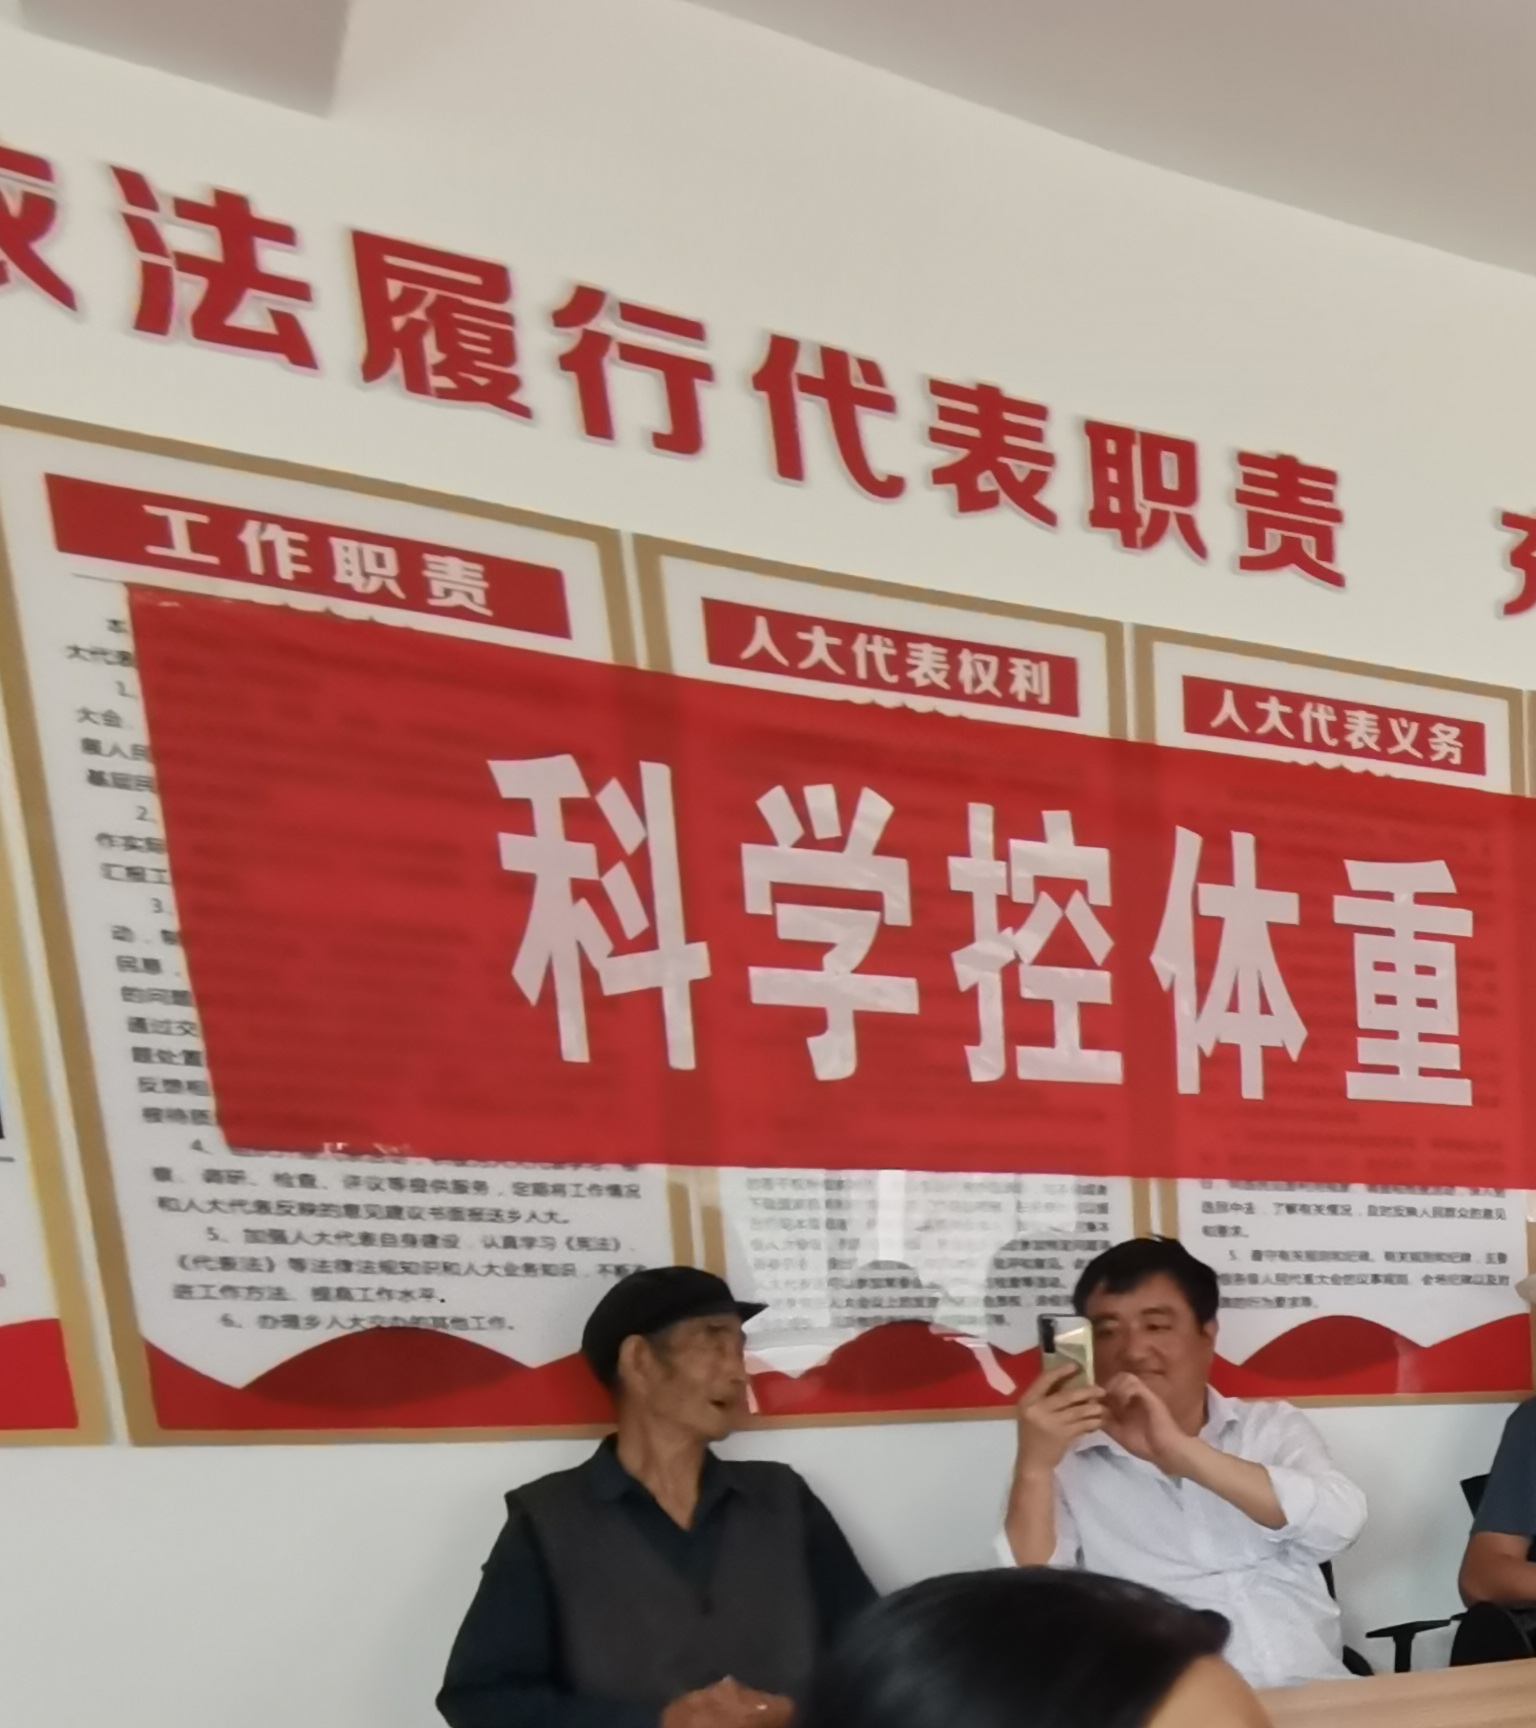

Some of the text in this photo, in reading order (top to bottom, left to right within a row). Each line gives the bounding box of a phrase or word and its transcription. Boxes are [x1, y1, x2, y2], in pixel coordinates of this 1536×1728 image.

[142, 505, 493, 616] 工作职责
[740, 615, 1051, 705] 人大代表权利
[1209, 690, 1463, 766] 人大代表义务
[488, 754, 1474, 1107] 科学控体重
